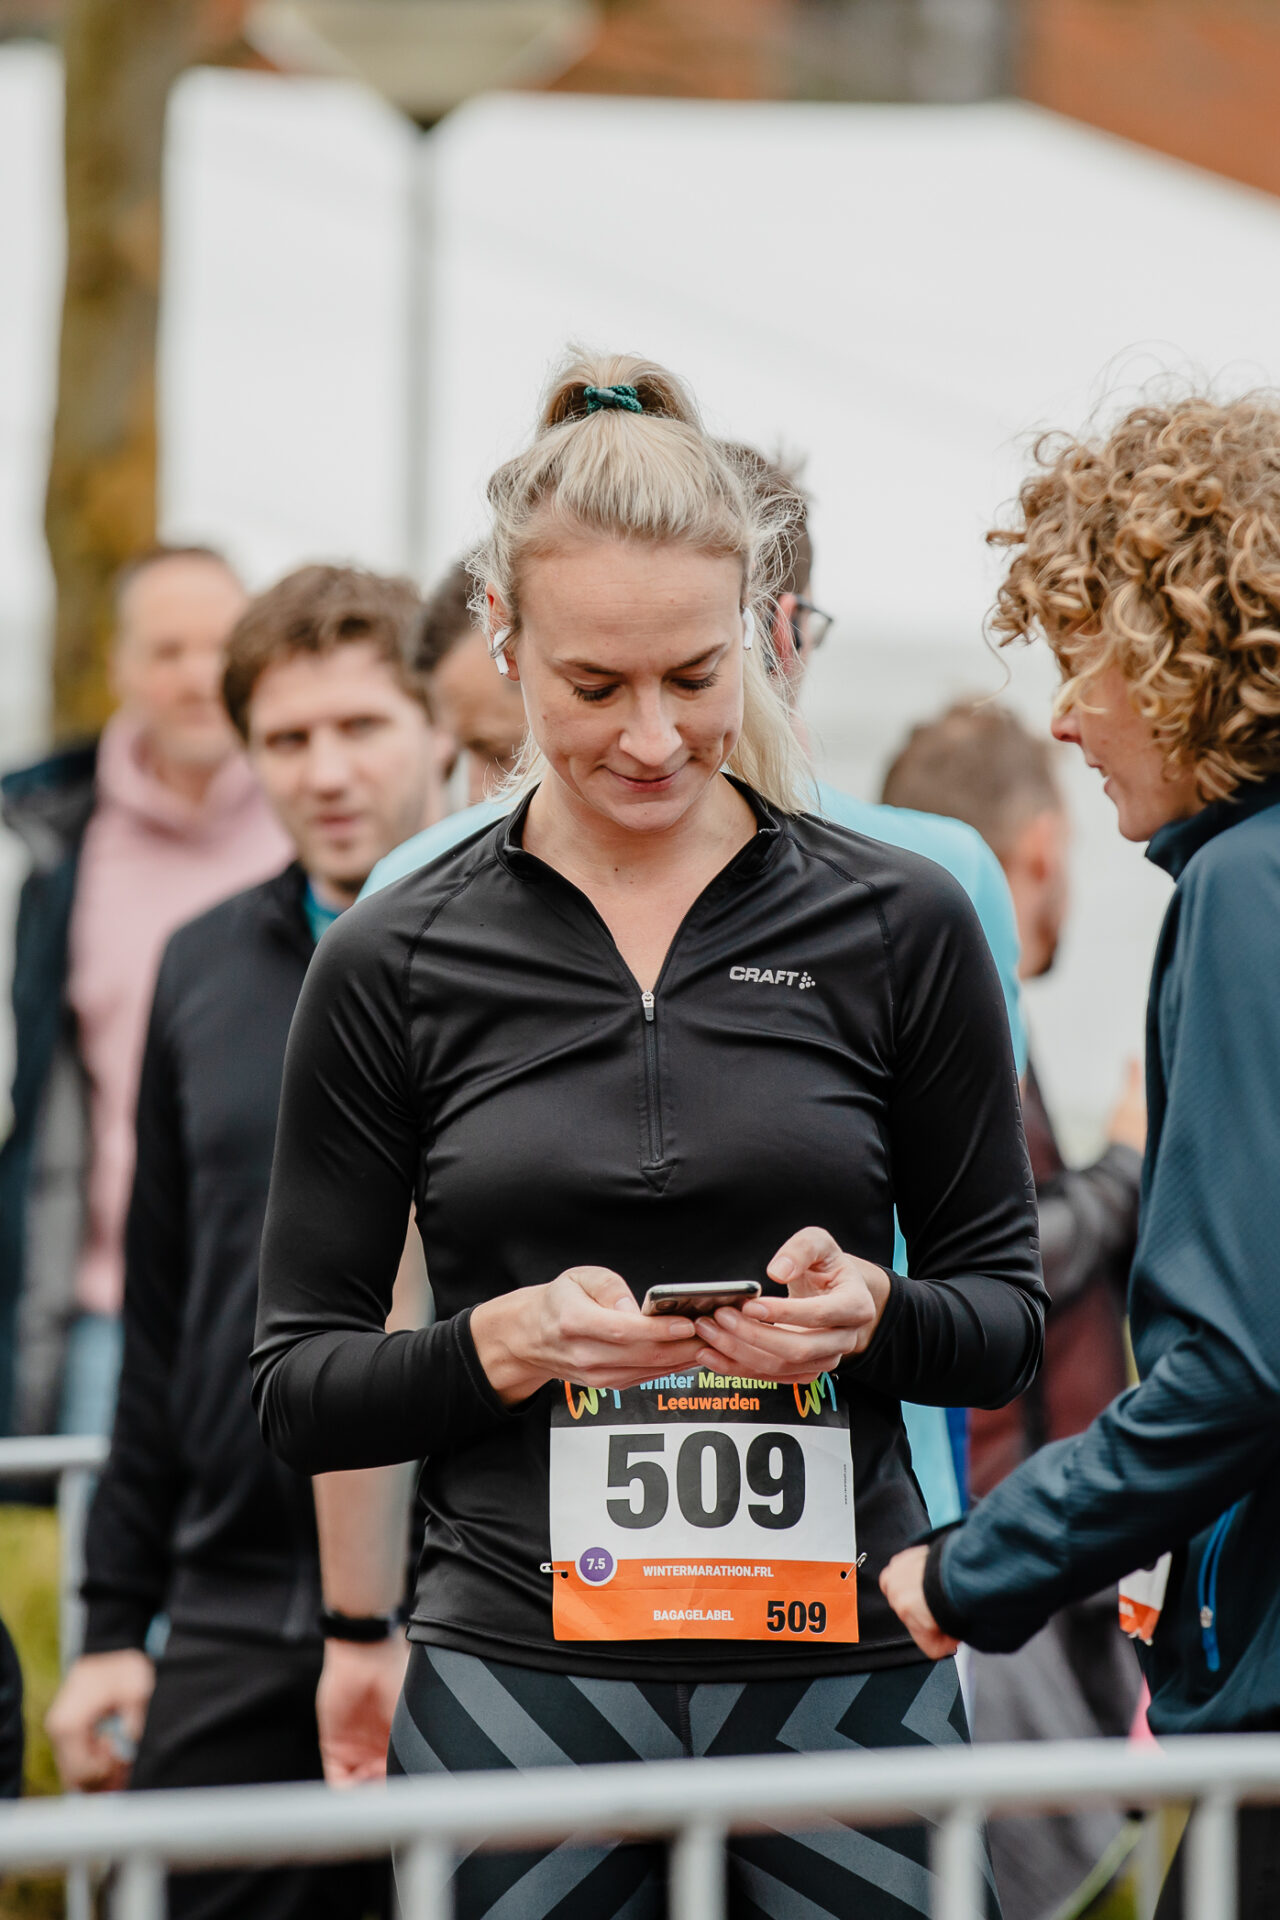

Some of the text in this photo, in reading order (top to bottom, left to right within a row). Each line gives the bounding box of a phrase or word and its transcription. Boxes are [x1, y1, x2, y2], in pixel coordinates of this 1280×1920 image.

[729, 965, 799, 986] CRAFT
[639, 1372, 778, 1390] Winter Marathon
[657, 1393, 760, 1411] Leeuwarden
[606, 1430, 806, 1530] 509
[586, 1558, 606, 1570] 7.5
[643, 1565, 774, 1578] WINTERMARATHON.FRL
[653, 1610, 734, 1621] BAGAGELABEL
[766, 1600, 827, 1633] 509
